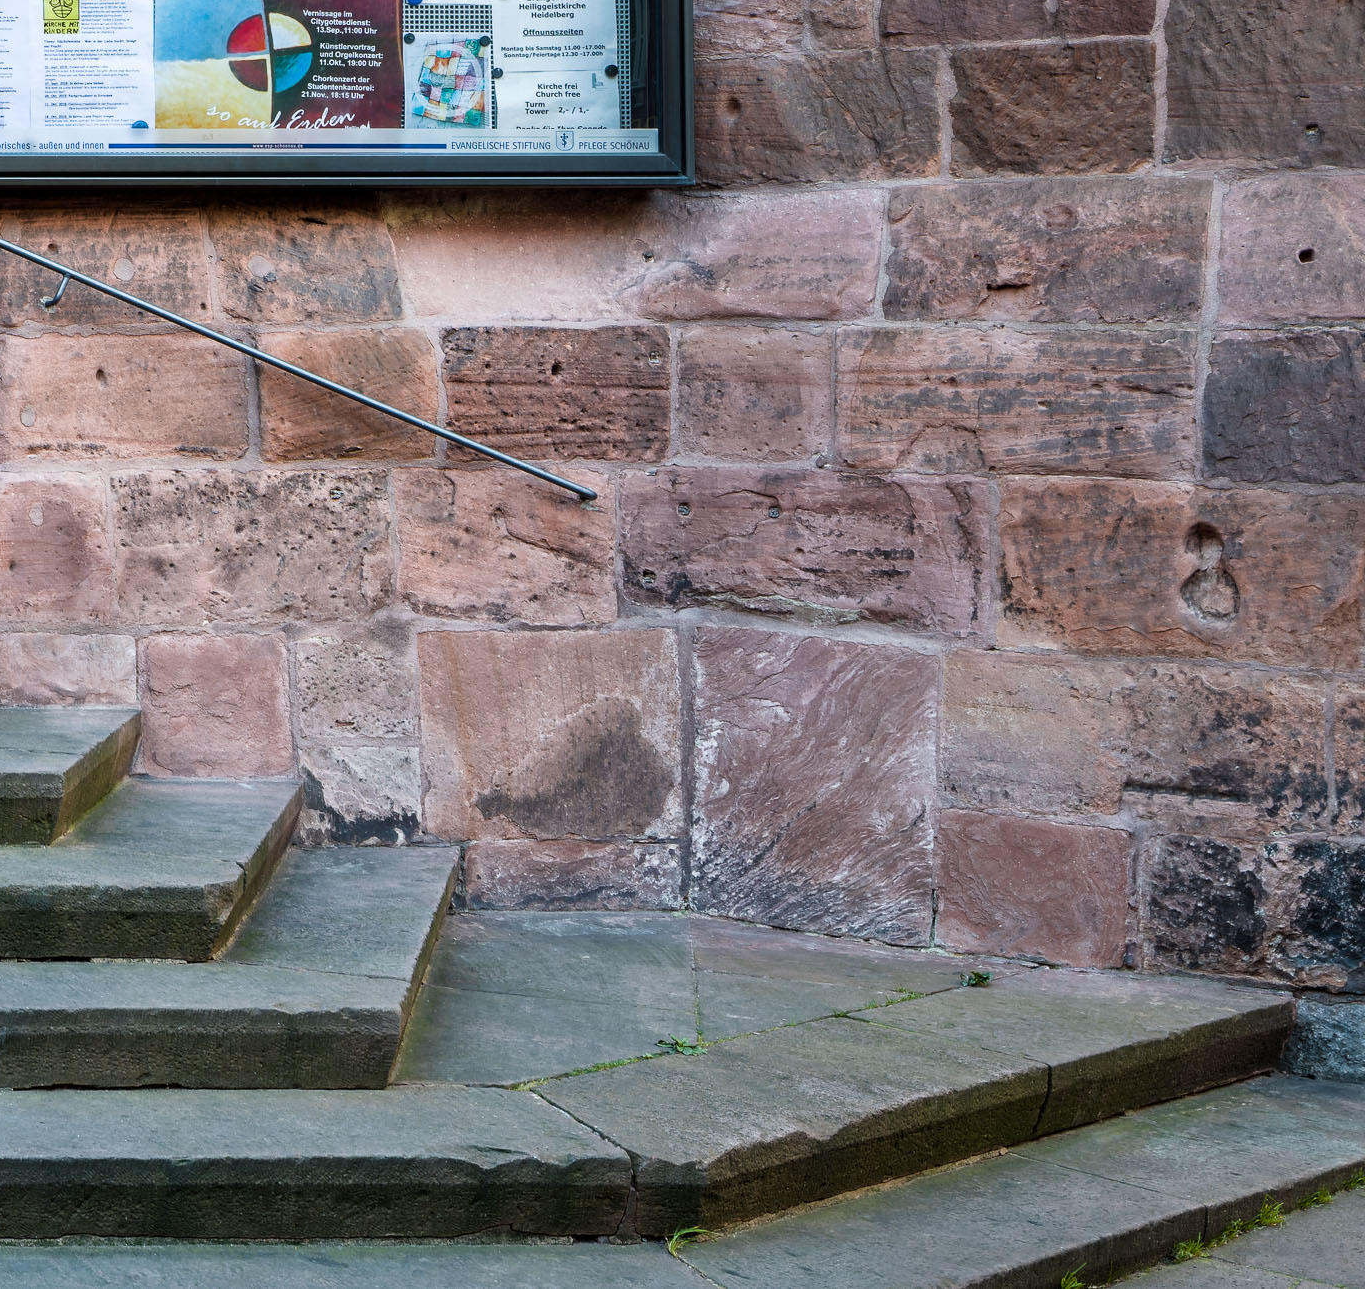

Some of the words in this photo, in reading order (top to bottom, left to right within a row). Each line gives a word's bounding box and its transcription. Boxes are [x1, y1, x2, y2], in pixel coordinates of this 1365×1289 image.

[519, 3, 586, 11] Heiliggeistkirche
[303, 10, 341, 18] Vernissage
[531, 11, 574, 19] Heidelberg
[311, 18, 370, 26] Citygottesdienst:
[523, 28, 583, 37] Öffnungszeiten
[320, 43, 375, 51] Künstlervortrag
[312, 75, 356, 83] Chorkonzert
[307, 83, 375, 91] Studentenkantorei:
[206, 106, 231, 121] so
[286, 107, 355, 129] Erden
[39, 141, 63, 150] außen
[66, 141, 80, 150] und
[82, 141, 104, 150] innen
[451, 141, 509, 149] EVANGELISCHE
[513, 141, 550, 149] STIFTUNG
[579, 141, 607, 149] PFLEGE
[610, 140, 650, 149] SCHÖNAU
